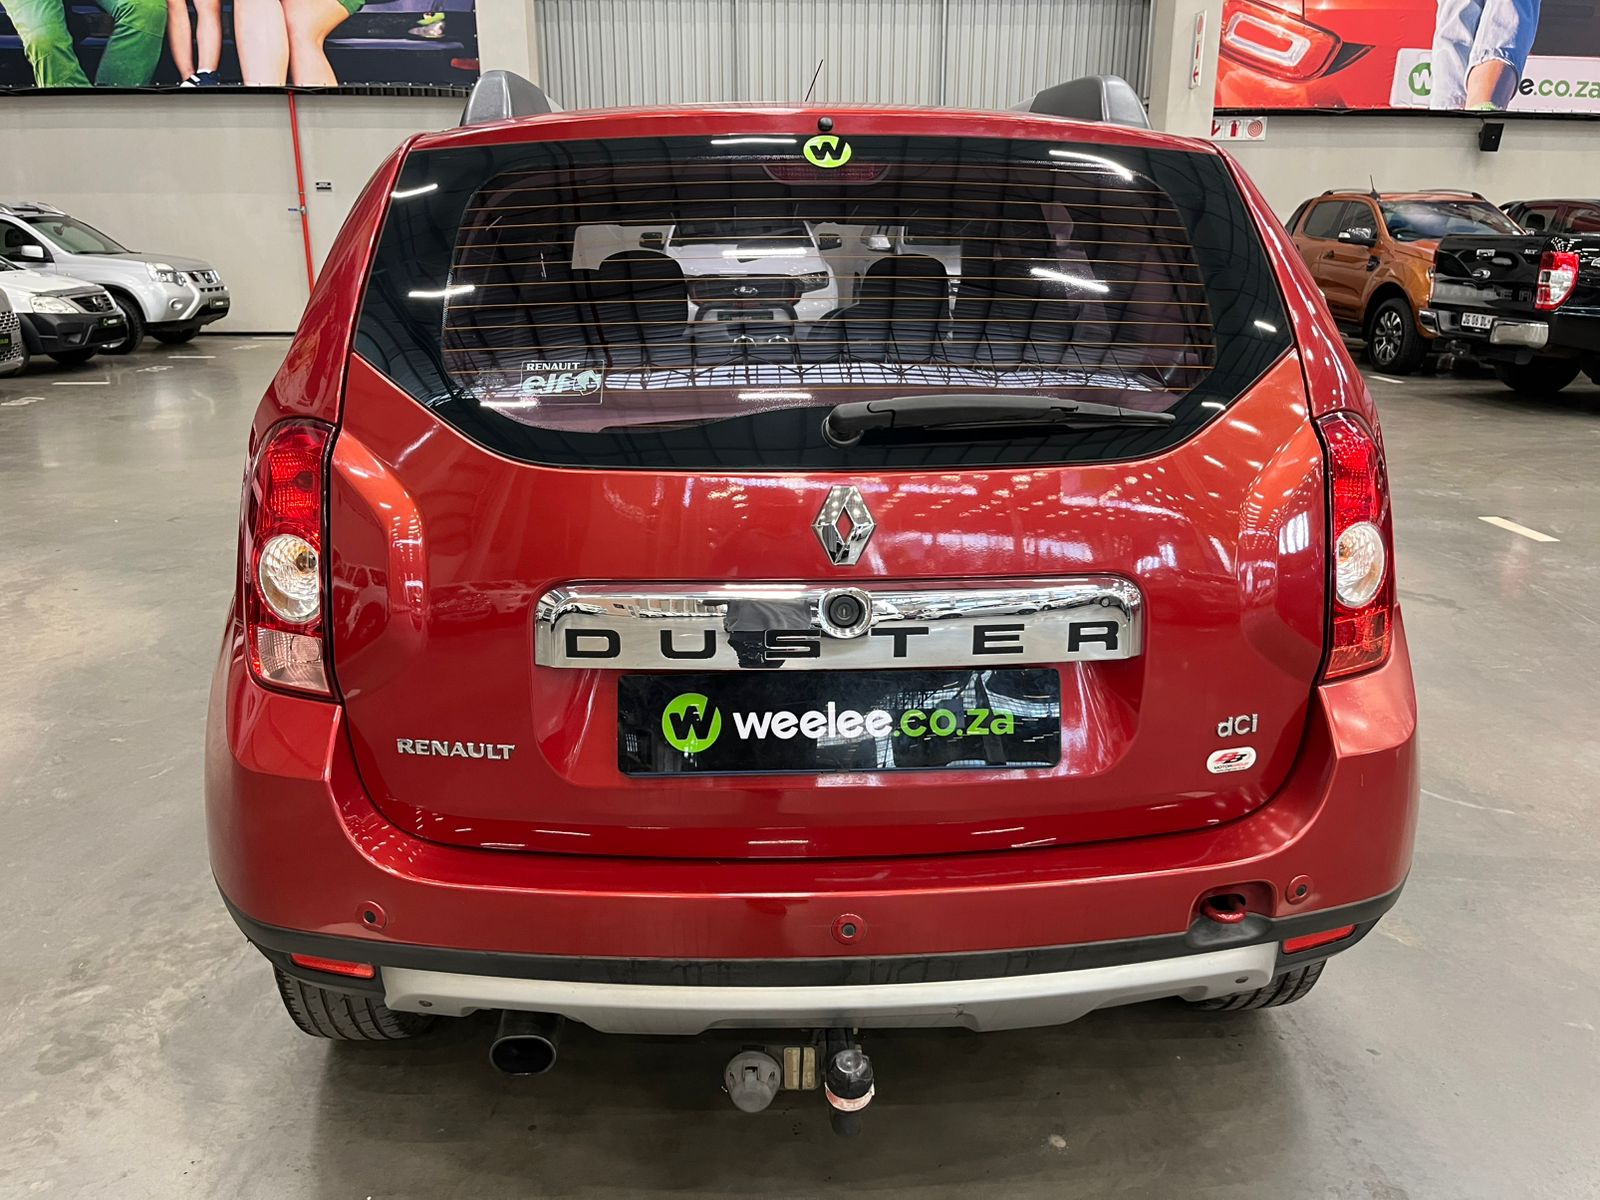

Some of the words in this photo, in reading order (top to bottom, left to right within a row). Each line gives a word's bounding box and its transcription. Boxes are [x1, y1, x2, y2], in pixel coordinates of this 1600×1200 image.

[526, 362, 581, 371] RENAULT
[564, 620, 1120, 660] DUSTER
[732, 701, 1015, 740] weelee.co.za
[396, 738, 516, 760] RENAULT
